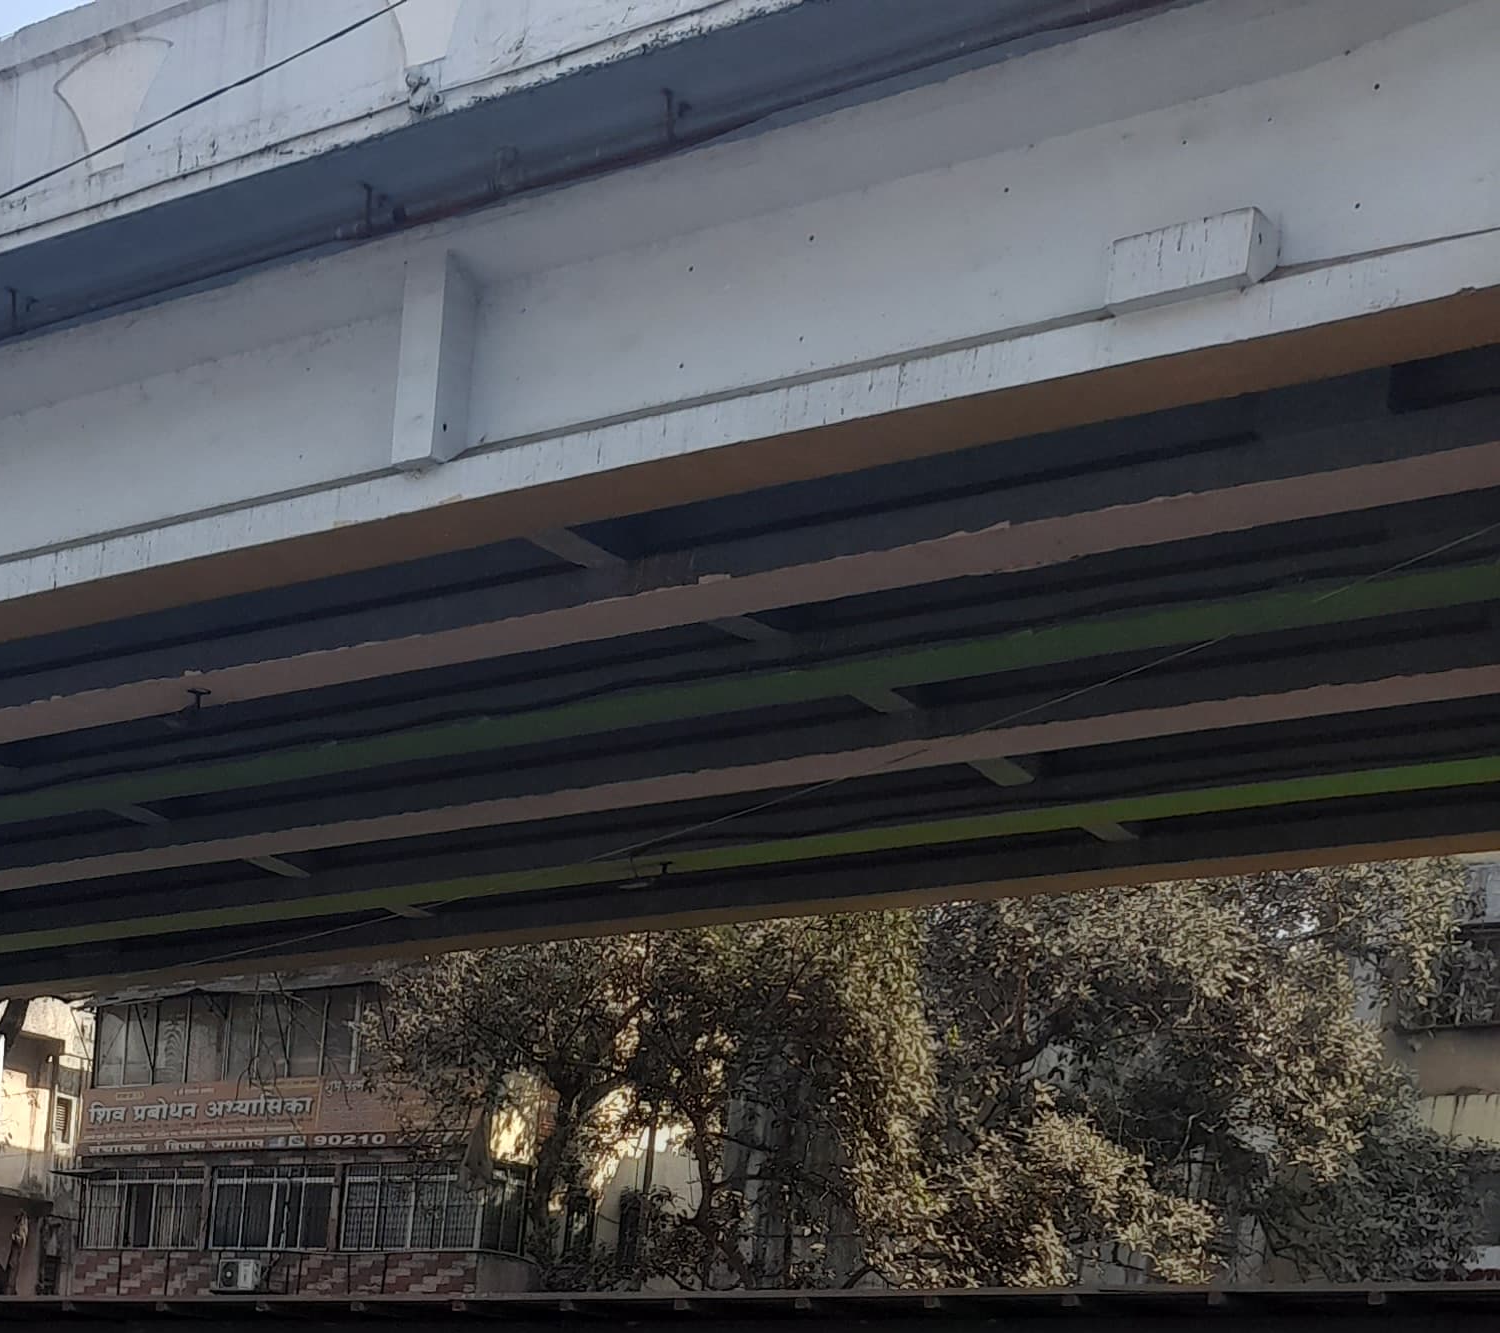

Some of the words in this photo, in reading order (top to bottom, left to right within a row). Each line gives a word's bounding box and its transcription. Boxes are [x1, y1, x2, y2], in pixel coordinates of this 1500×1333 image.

[88, 1101, 126, 1126] शिव
[132, 1096, 198, 1122] प्रबोधन
[314, 1133, 387, 1147] 90210
